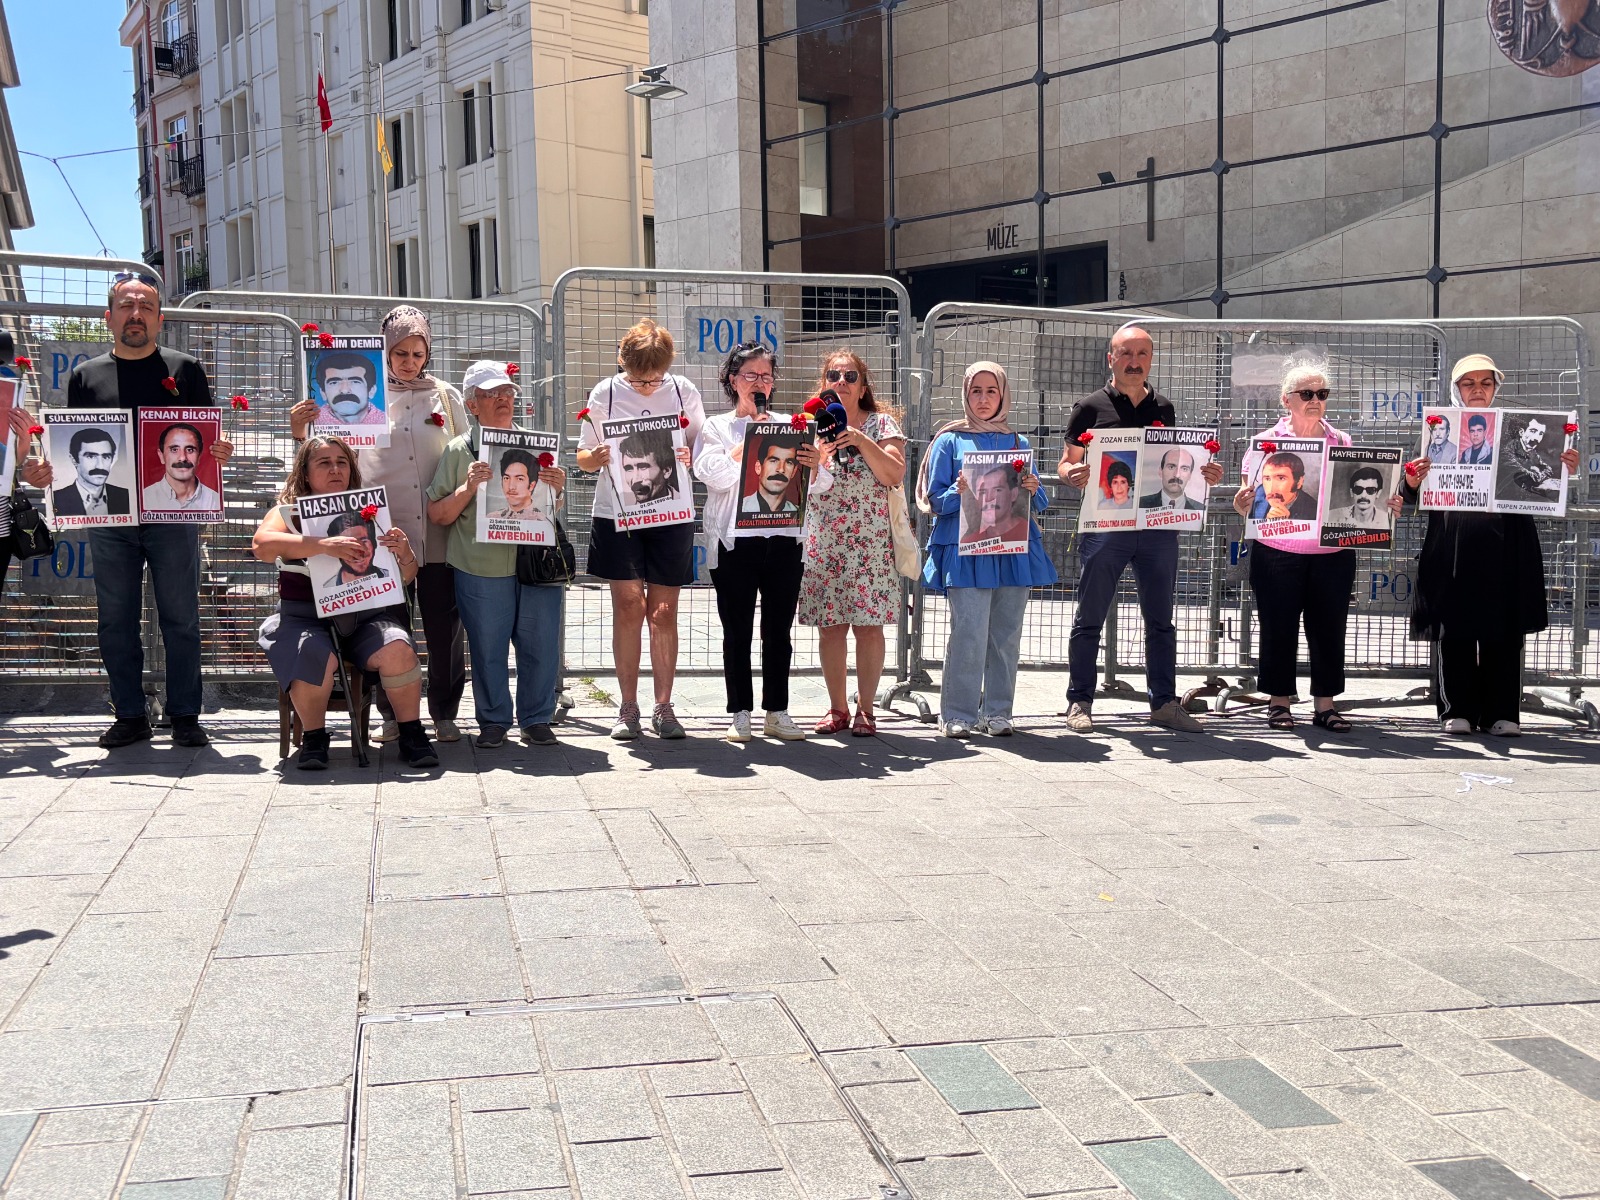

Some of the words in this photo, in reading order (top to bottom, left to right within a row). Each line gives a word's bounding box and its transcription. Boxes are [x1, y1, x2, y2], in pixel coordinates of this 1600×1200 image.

[987, 223, 1019, 251] MÜZE
[305, 338, 348, 349] İBRHİM
[350, 337, 382, 348] DEMİR
[48, 413, 98, 423] SÜLEYMAN
[98, 413, 127, 422] CİHAN
[140, 410, 179, 420] KENAN
[182, 408, 220, 420] BİLGİN
[605, 424, 632, 436] TALAT
[632, 417, 678, 433] TÜRKOĞLU
[755, 423, 779, 435] AGİT
[343, 434, 376, 446] EDİLDİ
[483, 431, 522, 445] MURAT
[523, 435, 557, 448] YILDIZ
[1100, 436, 1122, 444] ZOZAN
[1123, 435, 1141, 443] EREN
[1146, 430, 1174, 442] RIDVAN
[1281, 443, 1319, 451] KIRBAYIR
[963, 454, 995, 465] KASIM
[996, 453, 1031, 464] ALPSOY
[1331, 450, 1374, 459] HAYRETTİN
[1376, 452, 1398, 460] EREN
[302, 495, 346, 517] HASAN
[348, 490, 385, 511] OCAK
[1422, 490, 1433, 507] GÖZ
[1433, 491, 1456, 507] ALTINDA
[1456, 488, 1489, 508] KAYBEDİLDİ
[617, 508, 657, 518] GÖZALTINDA
[1518, 504, 1556, 512] ZARTANYAN
[51, 517, 64, 526] 29
[65, 516, 109, 525] TEMMUZ
[111, 515, 133, 524] 1981
[142, 511, 183, 522] GÖZALTINDA
[184, 510, 223, 521] KAYBEDİLDİ
[617, 508, 691, 528] KAYBEDİLDİ
[1146, 511, 1201, 528] KAYBEDİLDİ
[488, 530, 545, 542] KAYBEDİLDİ
[1262, 524, 1311, 537] KAYBEDİLDİ
[1322, 529, 1367, 540] GÖZALTINDA
[1338, 532, 1390, 547] KAYBEDİLDİ
[318, 584, 365, 605] GÖZALTINDA
[321, 578, 397, 615] KAYBEDİLDİ
